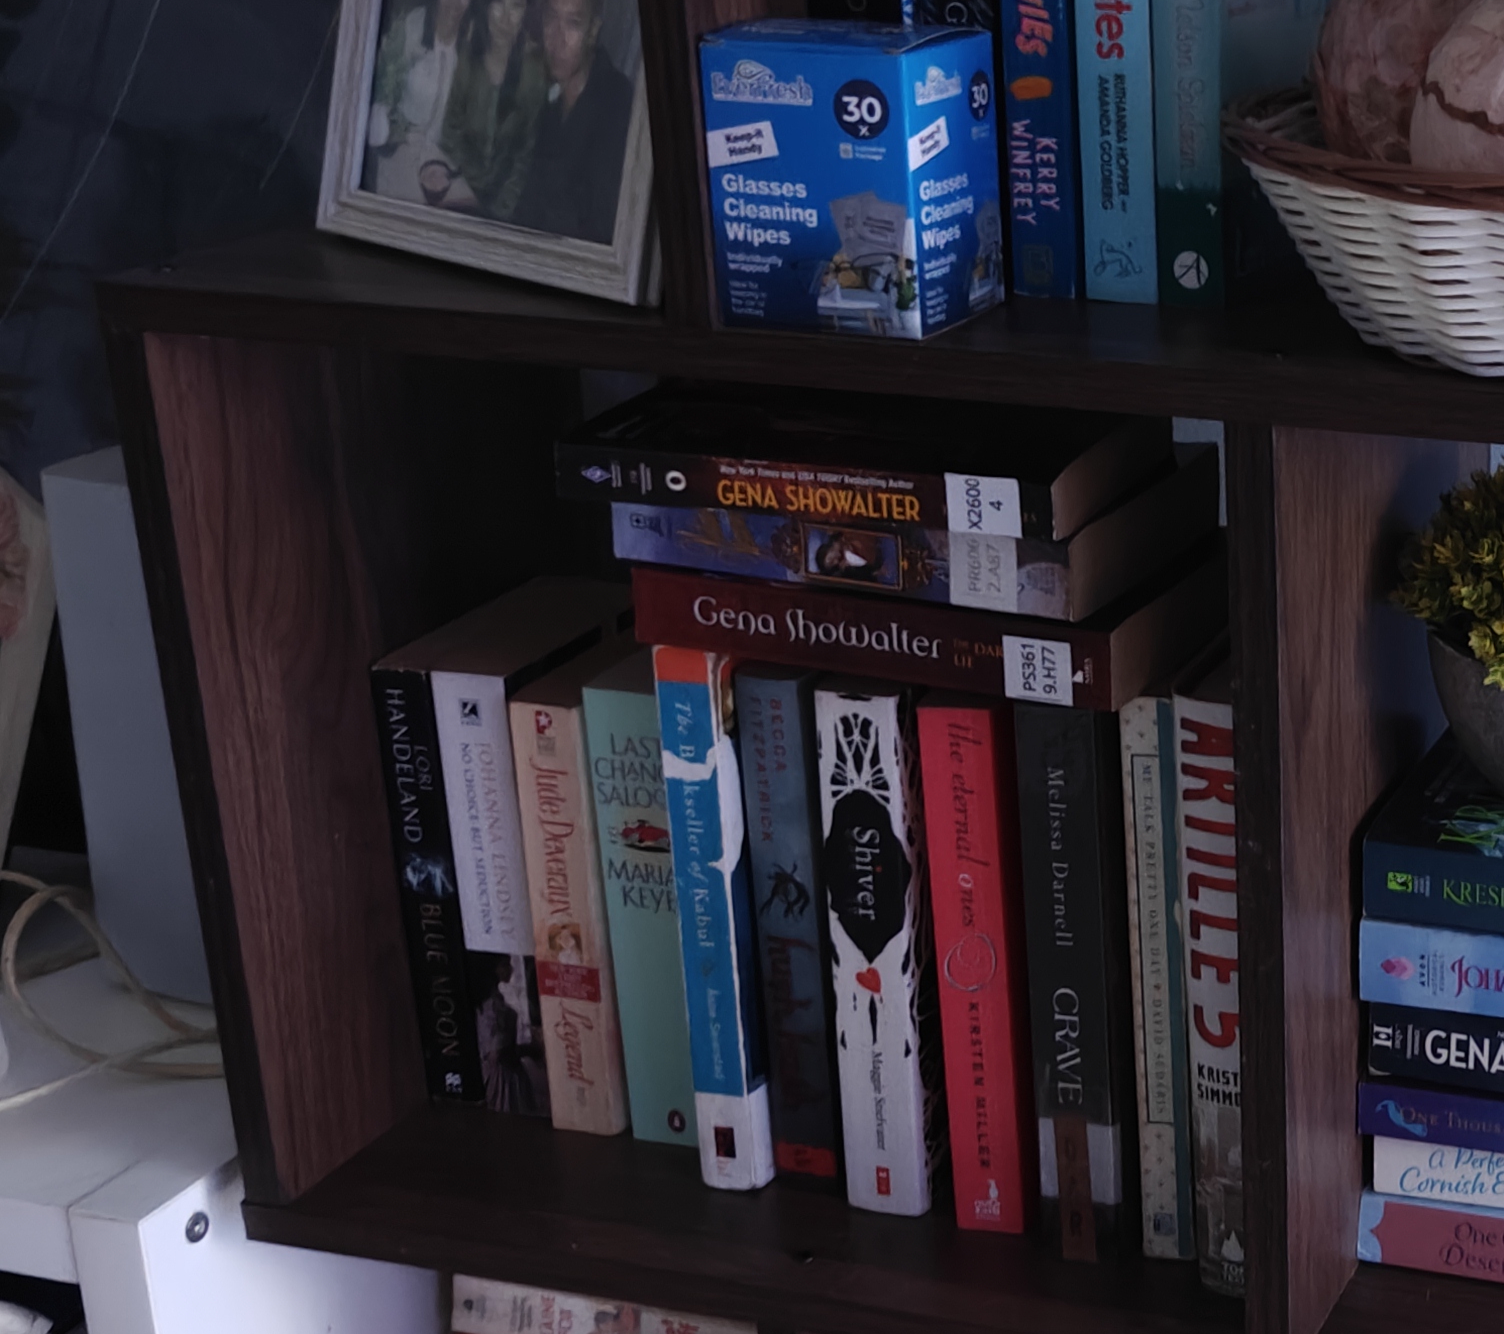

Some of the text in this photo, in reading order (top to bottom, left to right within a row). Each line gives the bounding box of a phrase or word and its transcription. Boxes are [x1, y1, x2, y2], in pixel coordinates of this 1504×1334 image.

[841, 95, 882, 123] 30
[971, 83, 989, 109] 30
[721, 173, 808, 199] Glasses
[919, 172, 970, 202] Glasses
[1010, 119, 1037, 225] WINFREY
[1034, 136, 1061, 211] KERRY
[722, 197, 819, 229] Cleaning
[724, 221, 792, 247] Wipes
[920, 196, 975, 227] Cleaning
[921, 224, 962, 251] Wipes
[717, 478, 921, 522] GENA SHOWALTER
[964, 477, 1004, 531] X2600 4
[692, 595, 777, 636] Gena
[785, 607, 943, 659] Showalter
[1021, 643, 1036, 693] PS361
[1041, 645, 1058, 695] 9.H77
[610, 733, 662, 759] LAST
[769, 697, 788, 772] BECCA
[385, 688, 424, 843] HANDELAND
[413, 743, 434, 792] LORI
[529, 757, 569, 815] Jude
[750, 695, 774, 843] FITZPATRICK
[461, 742, 484, 854] NO CHOICE BUT
[674, 700, 716, 949] The of Kabul
[947, 722, 990, 929] the eternal ones
[474, 742, 516, 937] JOHANNA LINDSEY
[537, 816, 576, 918] Deveraux
[1046, 766, 1074, 947] Melissa Darnell
[852, 826, 880, 921] Shiver
[419, 902, 461, 1058] BLUE MOON
[554, 999, 595, 1088] Legend
[1051, 986, 1084, 1105] CRAVE
[1151, 998, 1165, 1046] DAVID
[967, 1001, 992, 1168] KIRSTEN MILLER
[1401, 1106, 1440, 1125] ONE
[1399, 1166, 1486, 1195] Cornish
[1428, 1148, 1446, 1168] A
[1454, 1221, 1497, 1247] One
